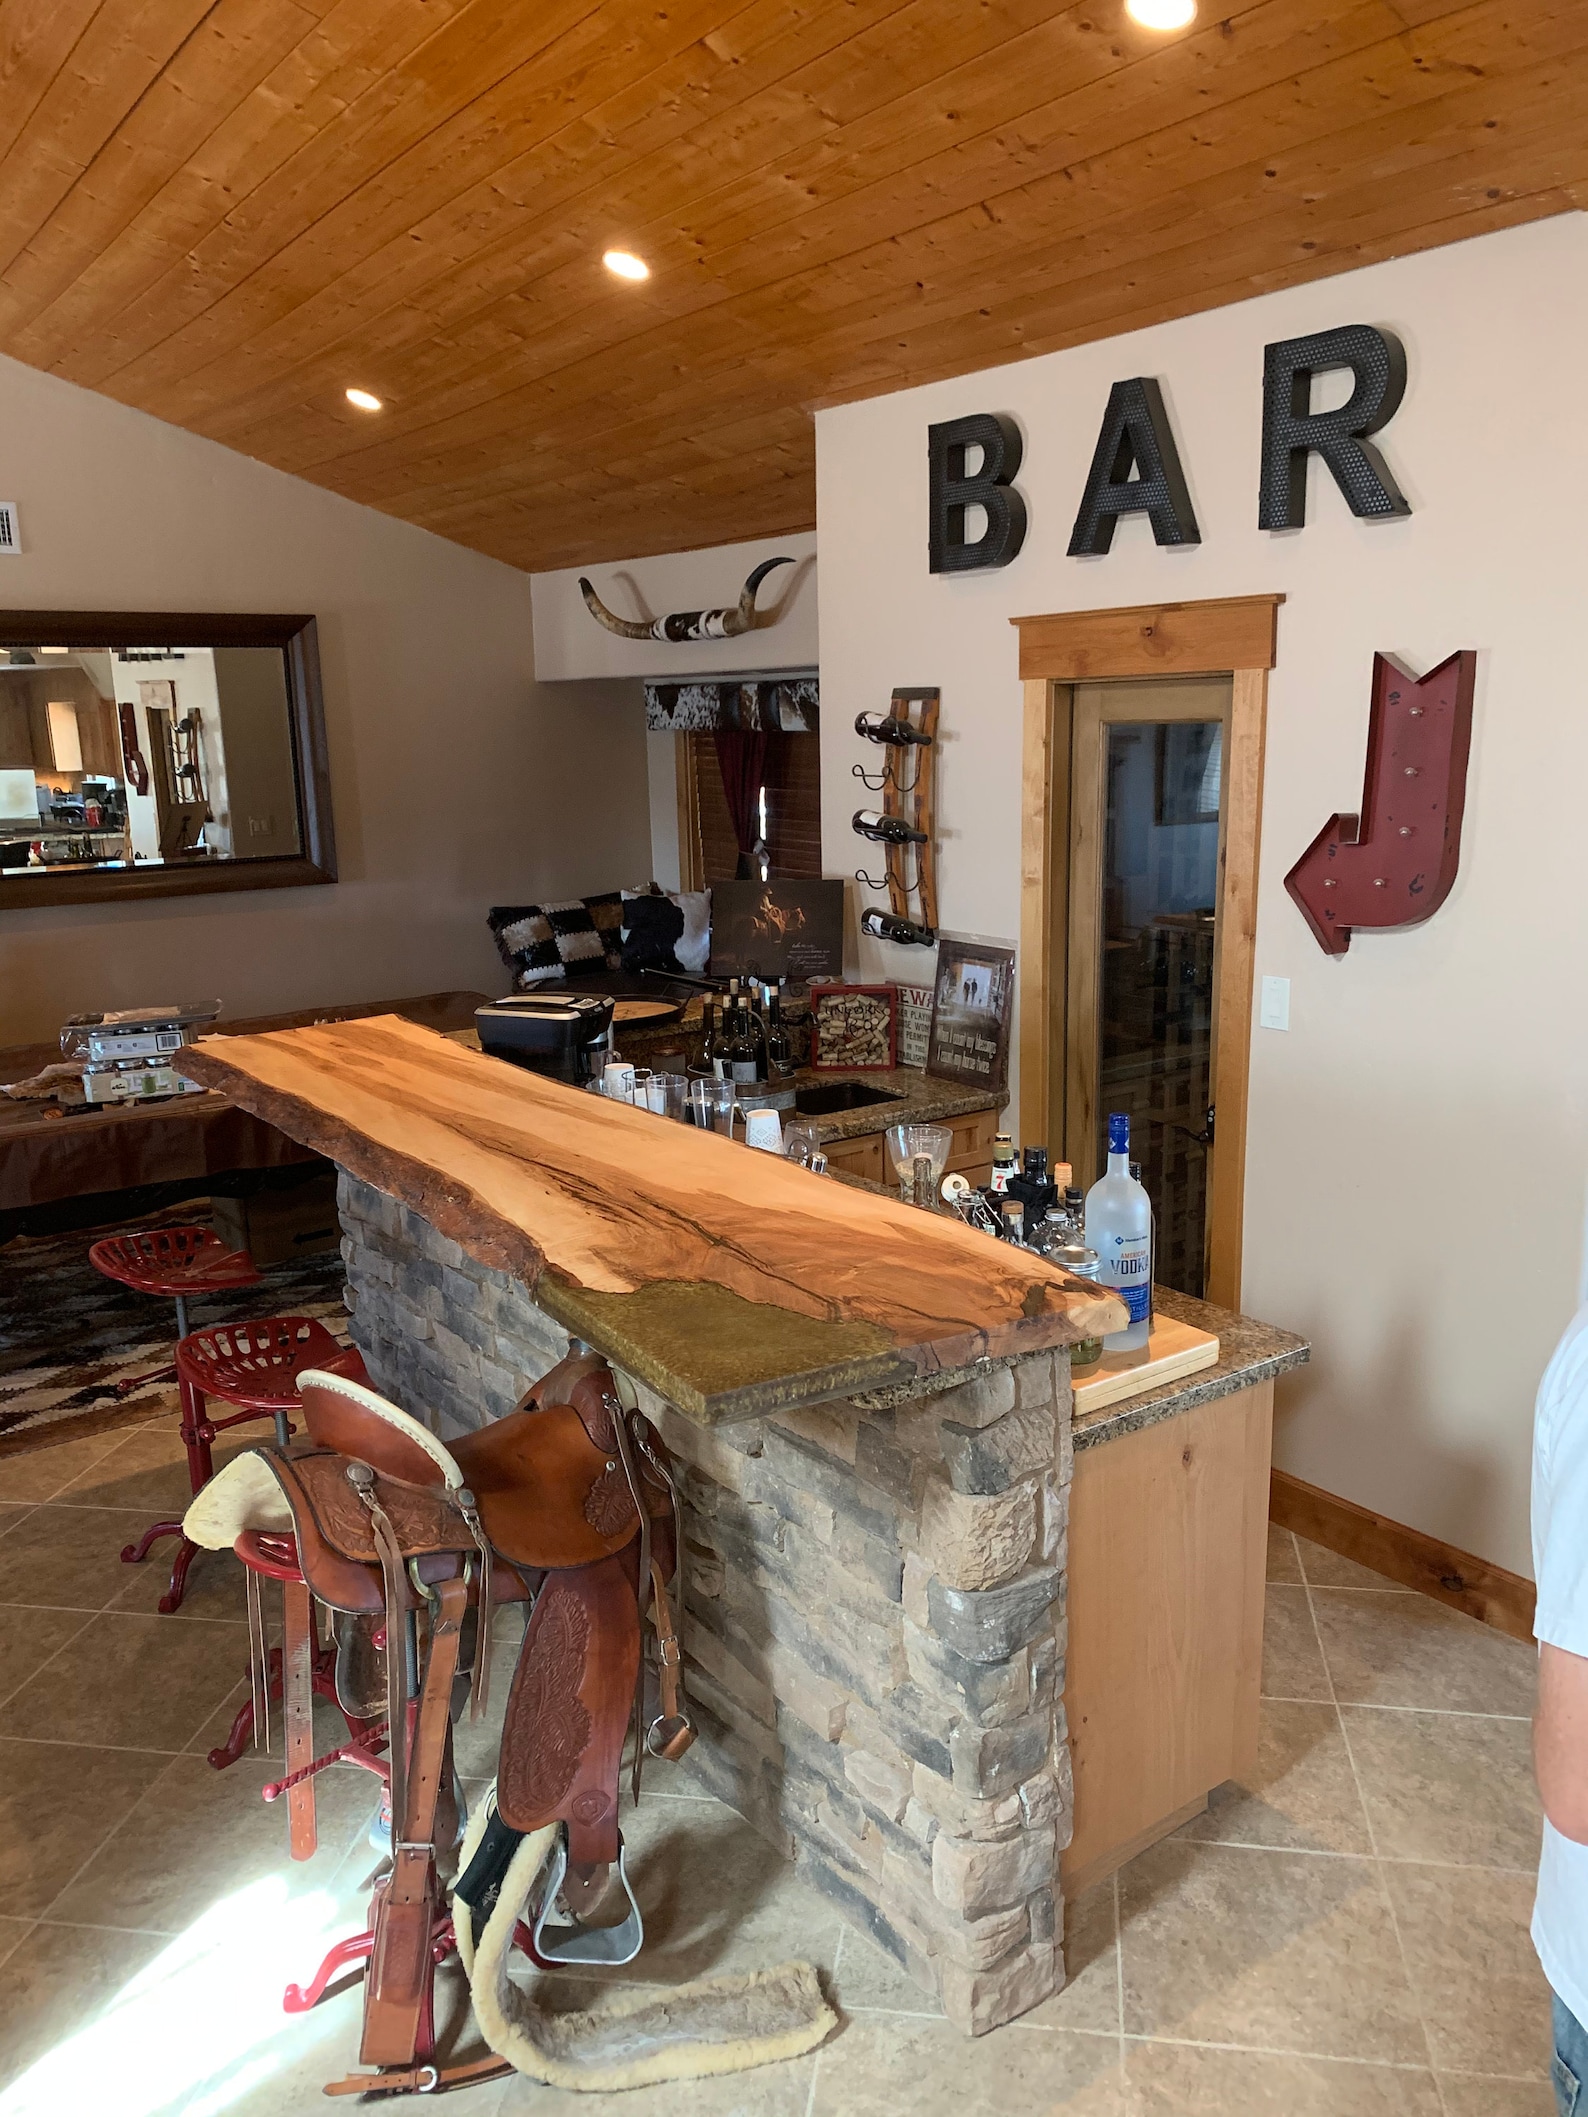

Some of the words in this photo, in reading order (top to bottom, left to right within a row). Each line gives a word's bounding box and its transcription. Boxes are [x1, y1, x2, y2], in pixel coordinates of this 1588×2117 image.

[928, 324, 1412, 575] BAR
[896, 989, 934, 1008] EWA
[996, 1176, 1005, 1190] 7
